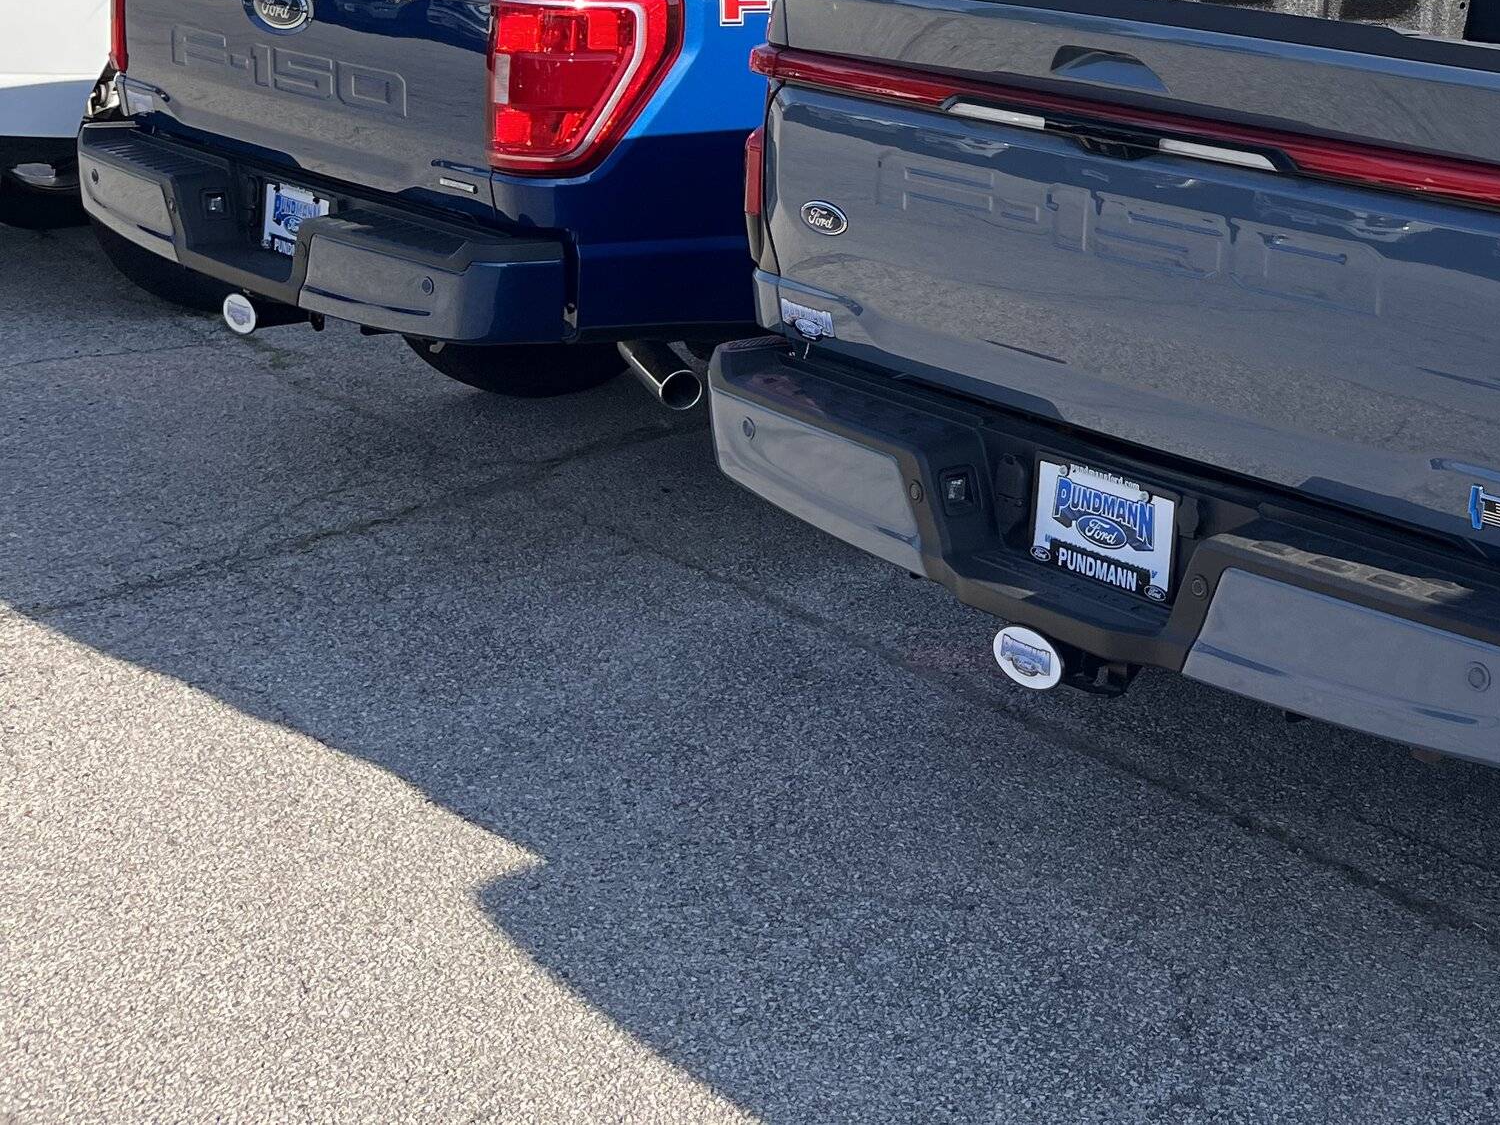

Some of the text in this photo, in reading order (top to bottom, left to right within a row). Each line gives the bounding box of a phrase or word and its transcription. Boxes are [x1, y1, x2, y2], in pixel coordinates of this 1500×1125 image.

[171, 25, 407, 118] F-150
[808, 207, 835, 229] Ford
[1052, 475, 1155, 551] PUNDMANN
[1085, 518, 1118, 545] Ford
[1057, 547, 1138, 592] PUNDMANN
